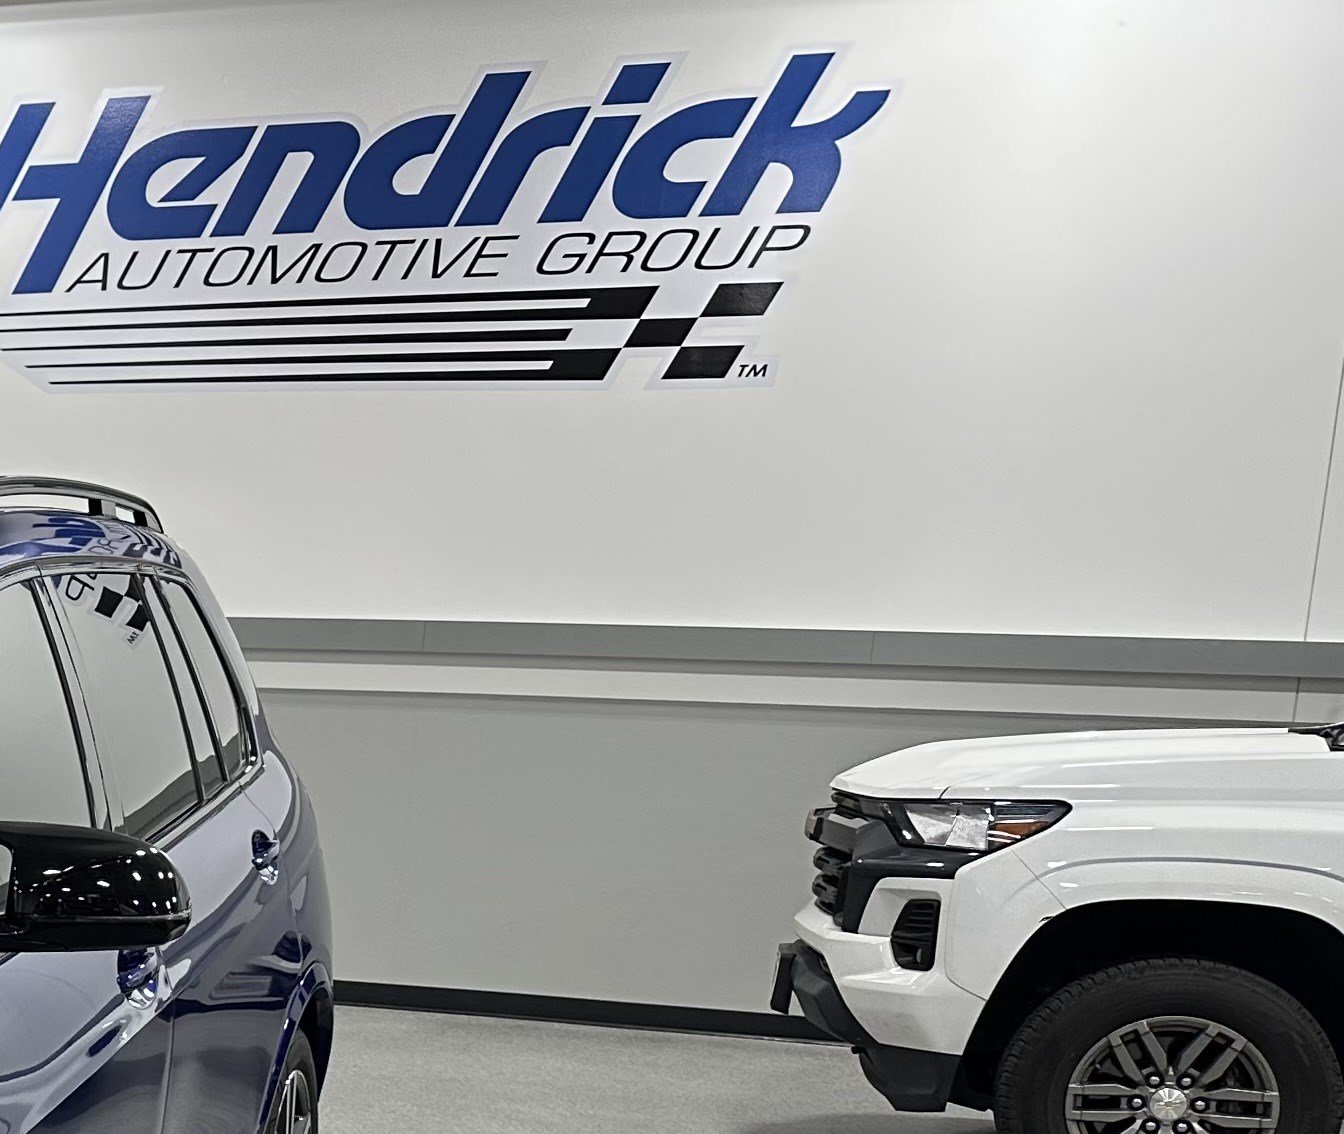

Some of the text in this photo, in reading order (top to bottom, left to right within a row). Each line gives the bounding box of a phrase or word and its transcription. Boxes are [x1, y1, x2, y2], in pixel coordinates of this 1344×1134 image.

[64, 224, 812, 293] AUTOMOTIVE GROUP
[738, 363, 768, 378] TM
